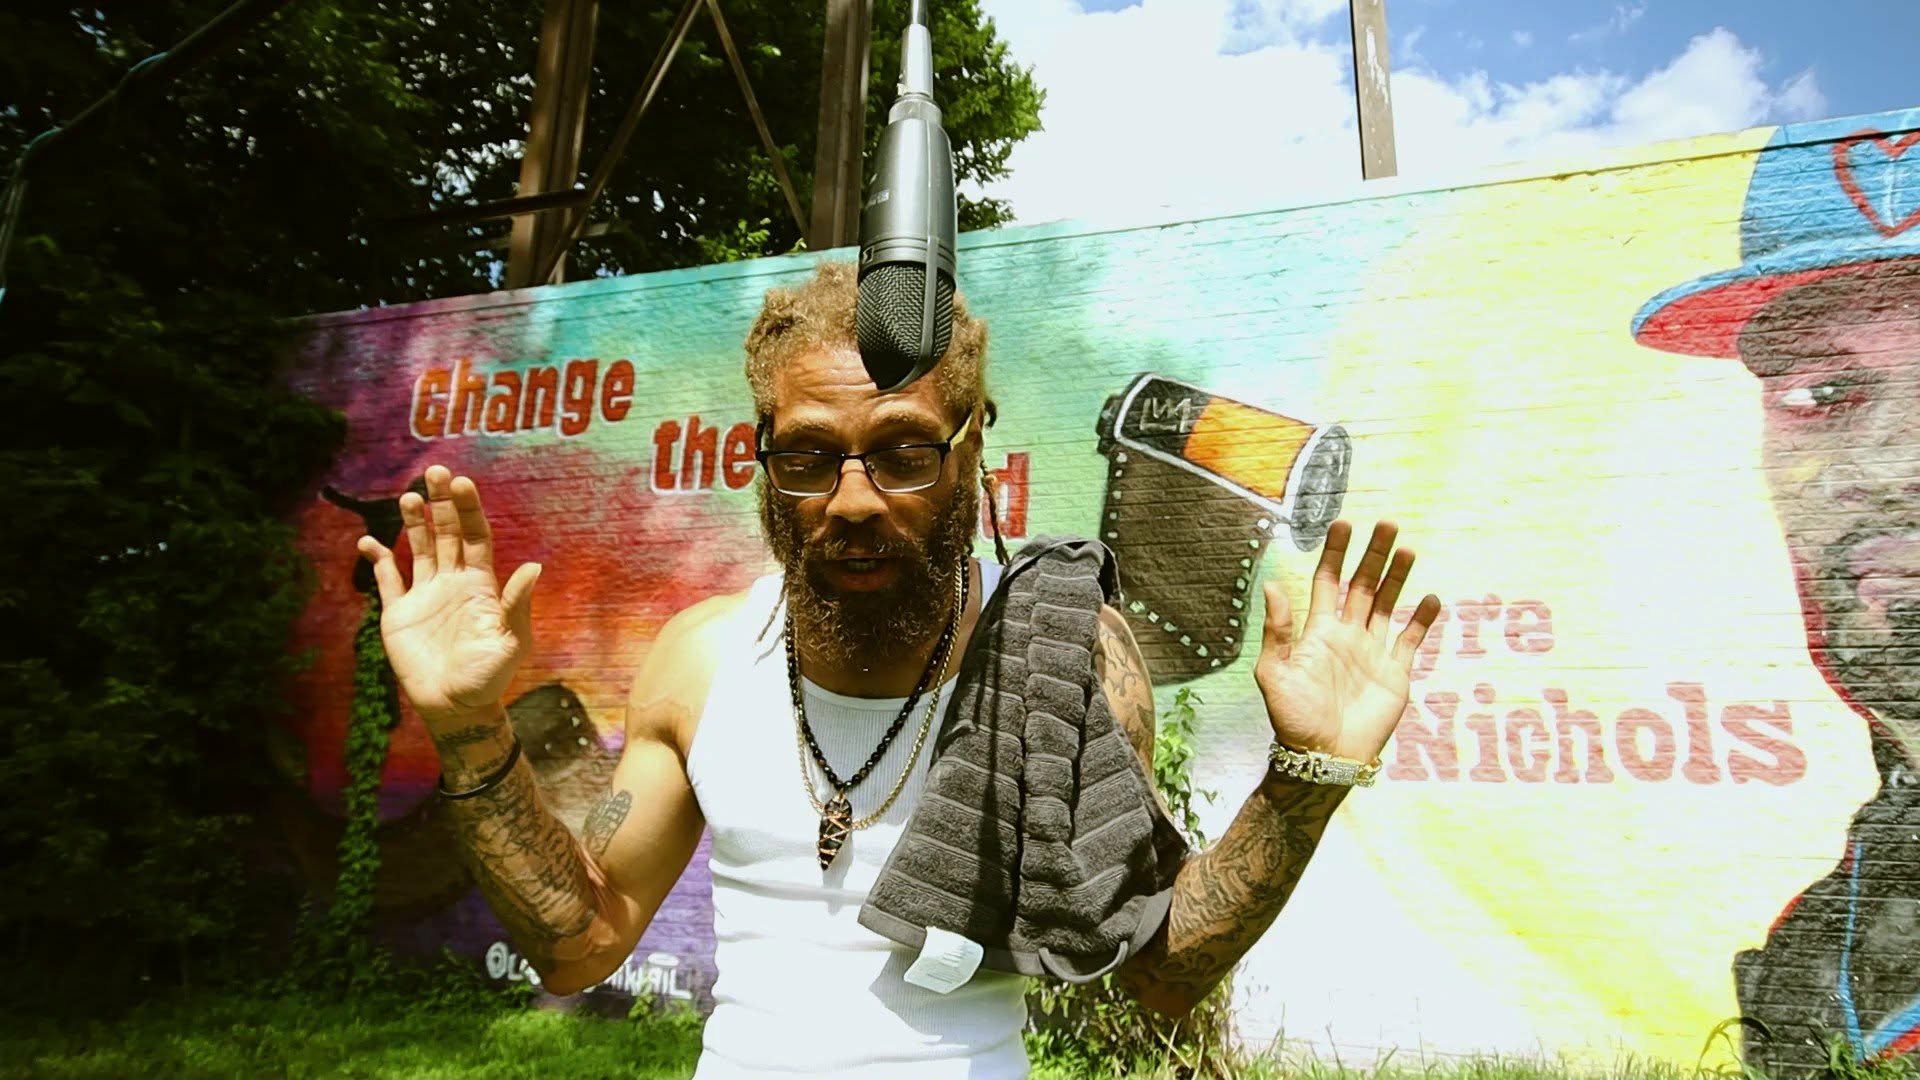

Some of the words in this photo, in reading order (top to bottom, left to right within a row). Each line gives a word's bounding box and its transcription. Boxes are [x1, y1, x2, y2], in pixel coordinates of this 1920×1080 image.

[410, 357, 635, 441] Change
[651, 414, 757, 494] the
[1338, 580, 1555, 681] yre
[1387, 682, 1808, 786] Nichols
